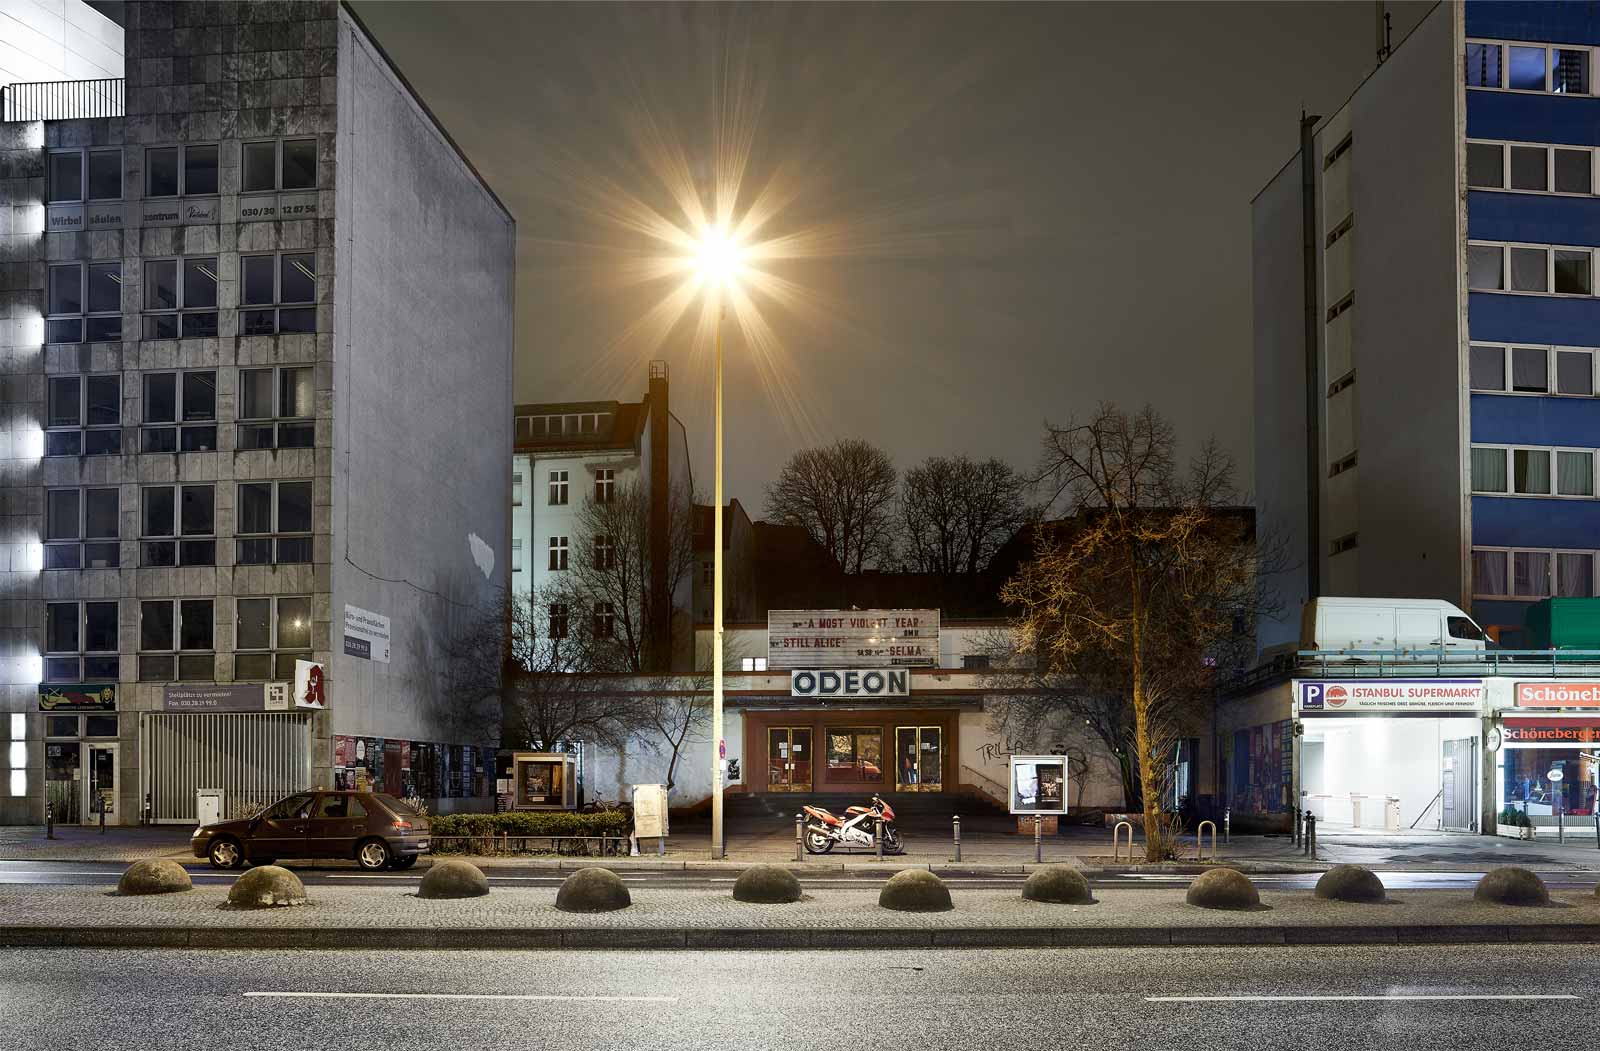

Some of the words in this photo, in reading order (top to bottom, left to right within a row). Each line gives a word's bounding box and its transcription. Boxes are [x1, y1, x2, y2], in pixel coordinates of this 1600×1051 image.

[242, 207, 275, 217] 030/30
[51, 215, 82, 226] Wirbel
[89, 214, 122, 225] säulen
[819, 618, 844, 628] MOST
[793, 671, 908, 695] ODEON
[1307, 686, 1321, 703] P
[1352, 688, 1405, 698] ISTANBUL
[1408, 688, 1481, 698] SUPERMARKT
[1522, 687, 1600, 701] Schöneb
